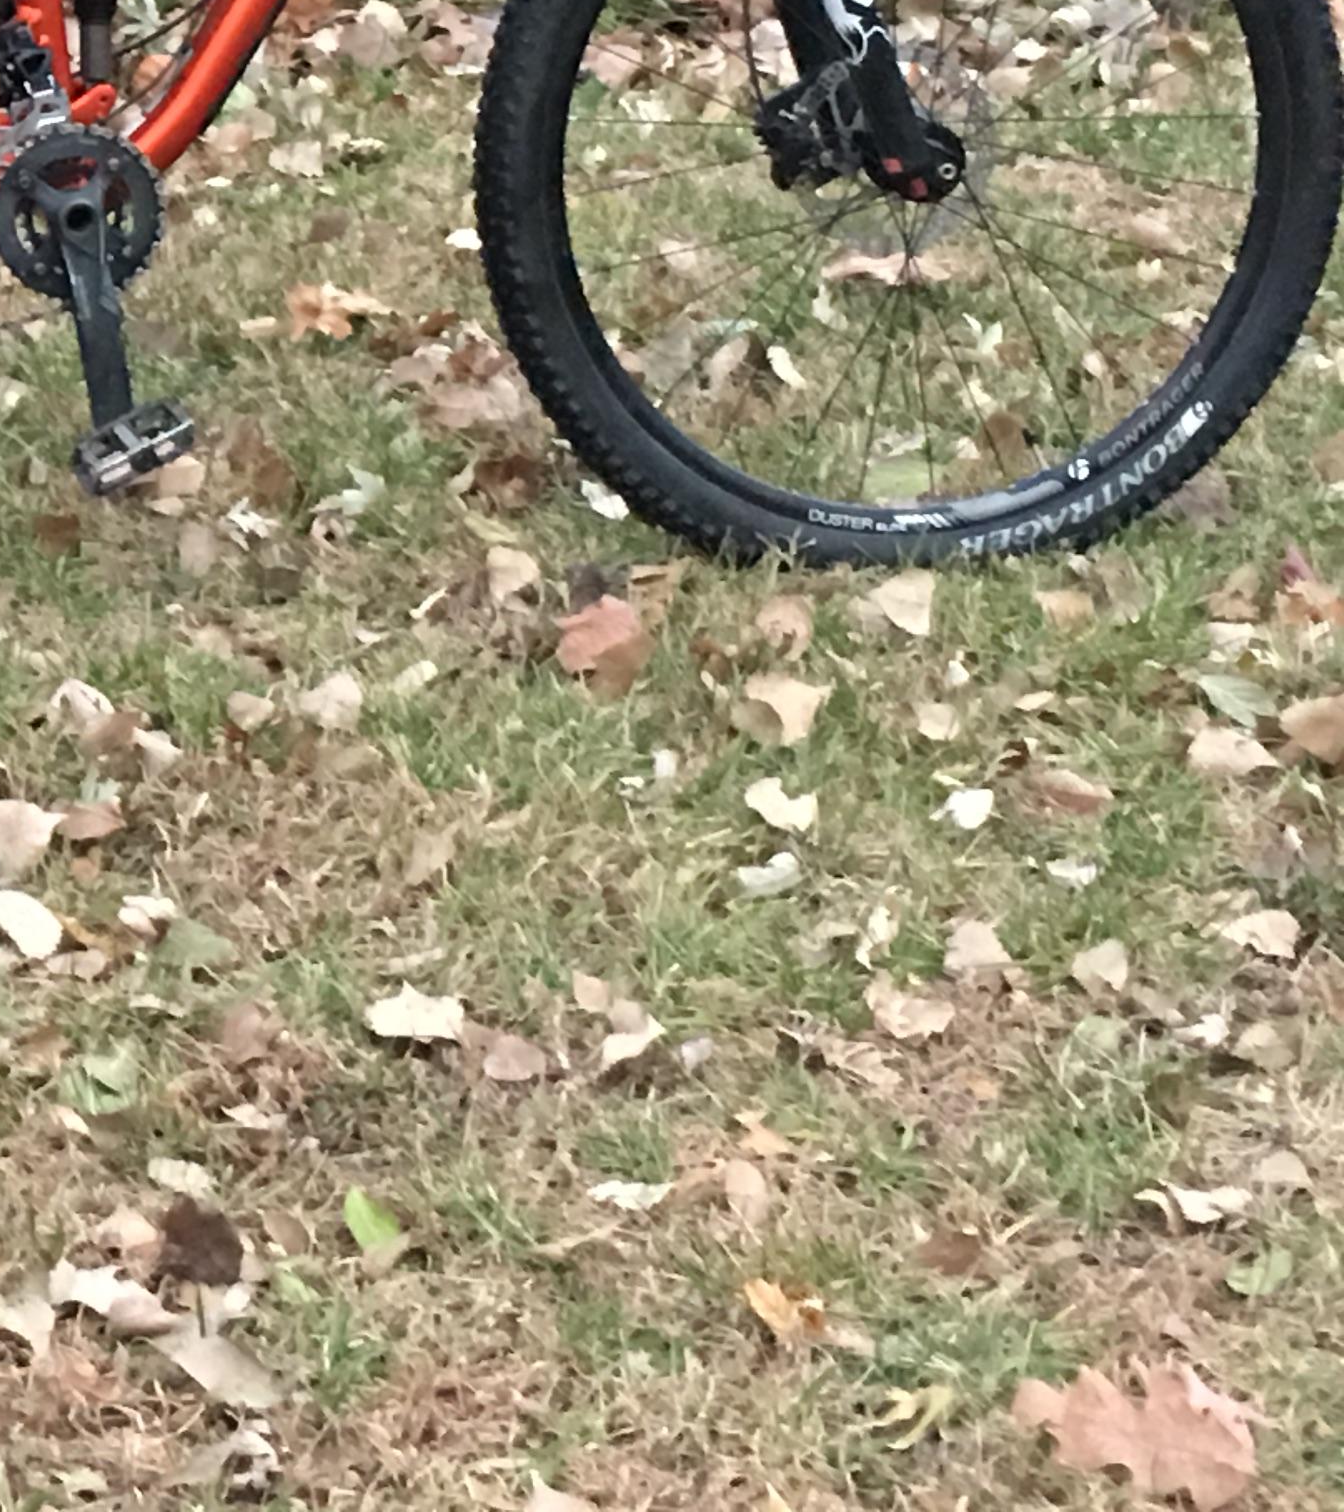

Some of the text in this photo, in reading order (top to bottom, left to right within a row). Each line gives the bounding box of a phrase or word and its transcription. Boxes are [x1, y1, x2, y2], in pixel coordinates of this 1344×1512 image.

[1098, 362, 1204, 467] BONTRAGER
[808, 508, 874, 530] DUSTER
[959, 423, 1188, 557] BONTRAGER
